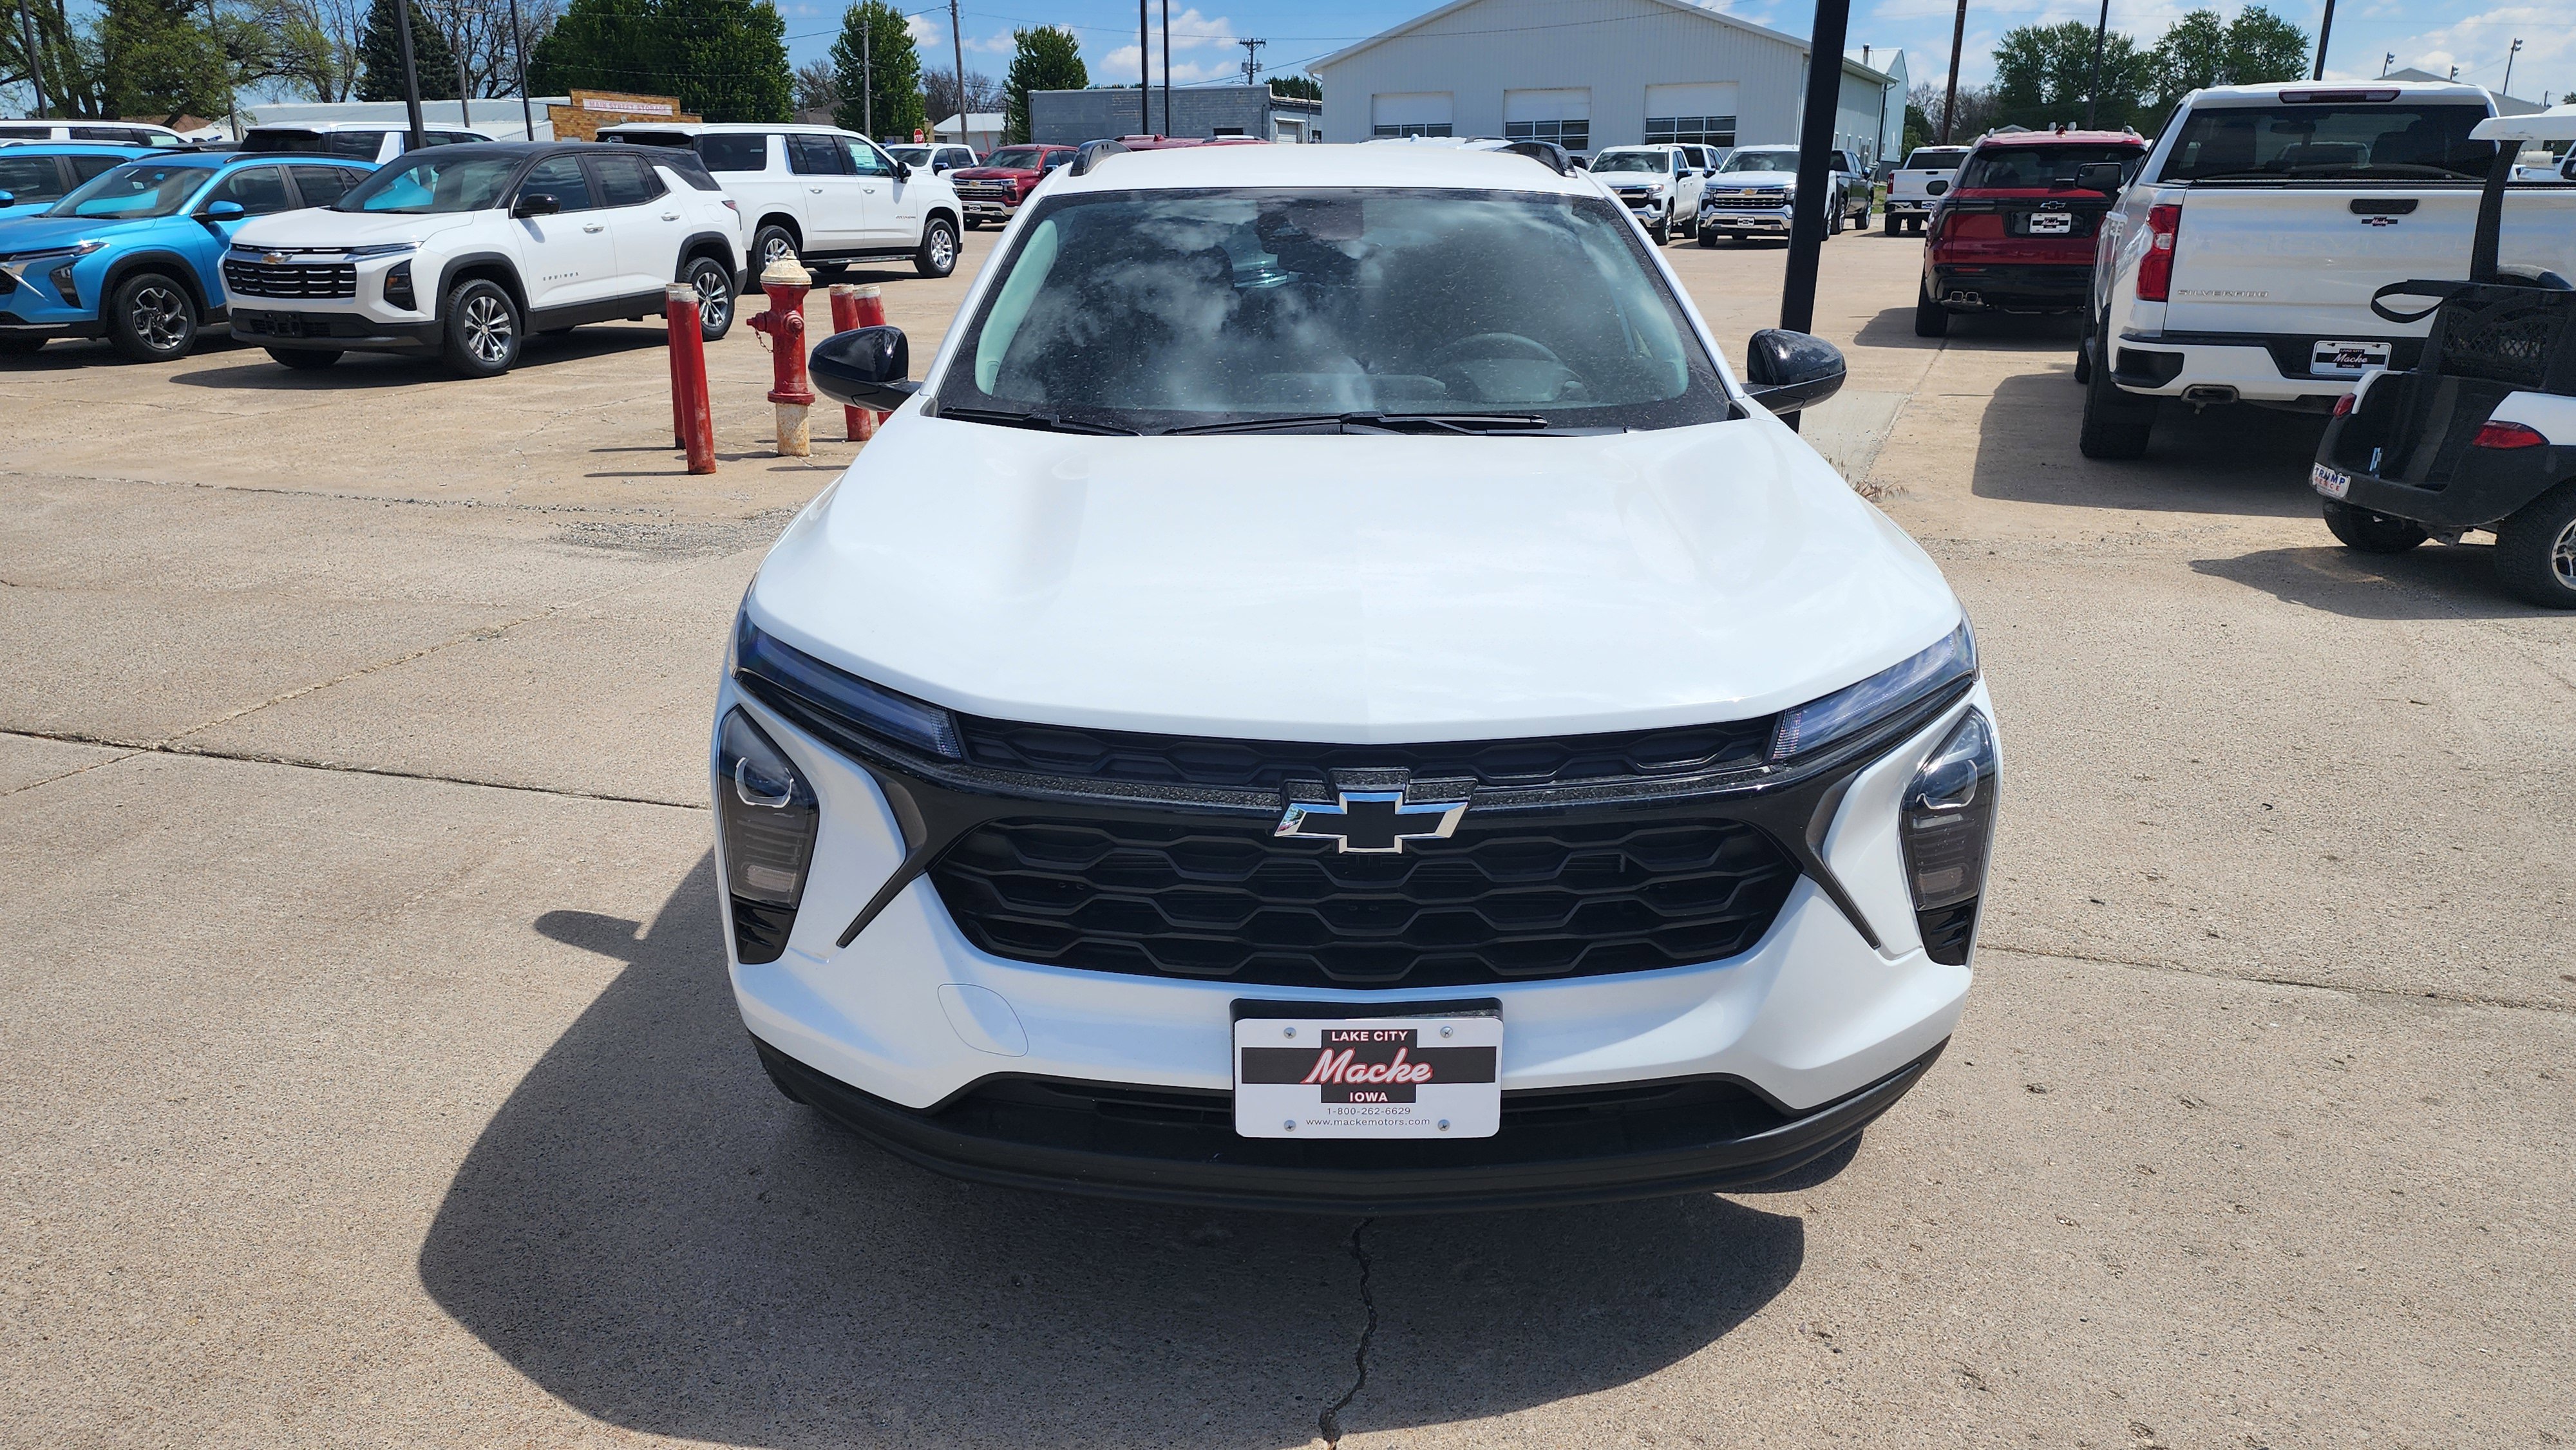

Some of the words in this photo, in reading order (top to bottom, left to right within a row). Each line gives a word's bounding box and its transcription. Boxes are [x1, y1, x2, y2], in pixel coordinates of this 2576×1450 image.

[914, 134, 924, 142] STOP
[2177, 288, 2269, 298] SILVERADO
[2333, 353, 2369, 362] Macke
[2314, 467, 2345, 485] TRUMP
[1331, 1031, 1369, 1042] LAKE
[1373, 1030, 1408, 1041] CITY
[1300, 1046, 1434, 1085] Macke
[1349, 1091, 1388, 1102] IOWA
[1327, 1107, 1411, 1116] 1-800-262-6629
[1305, 1116, 1430, 1126] www.mackemotors.com
